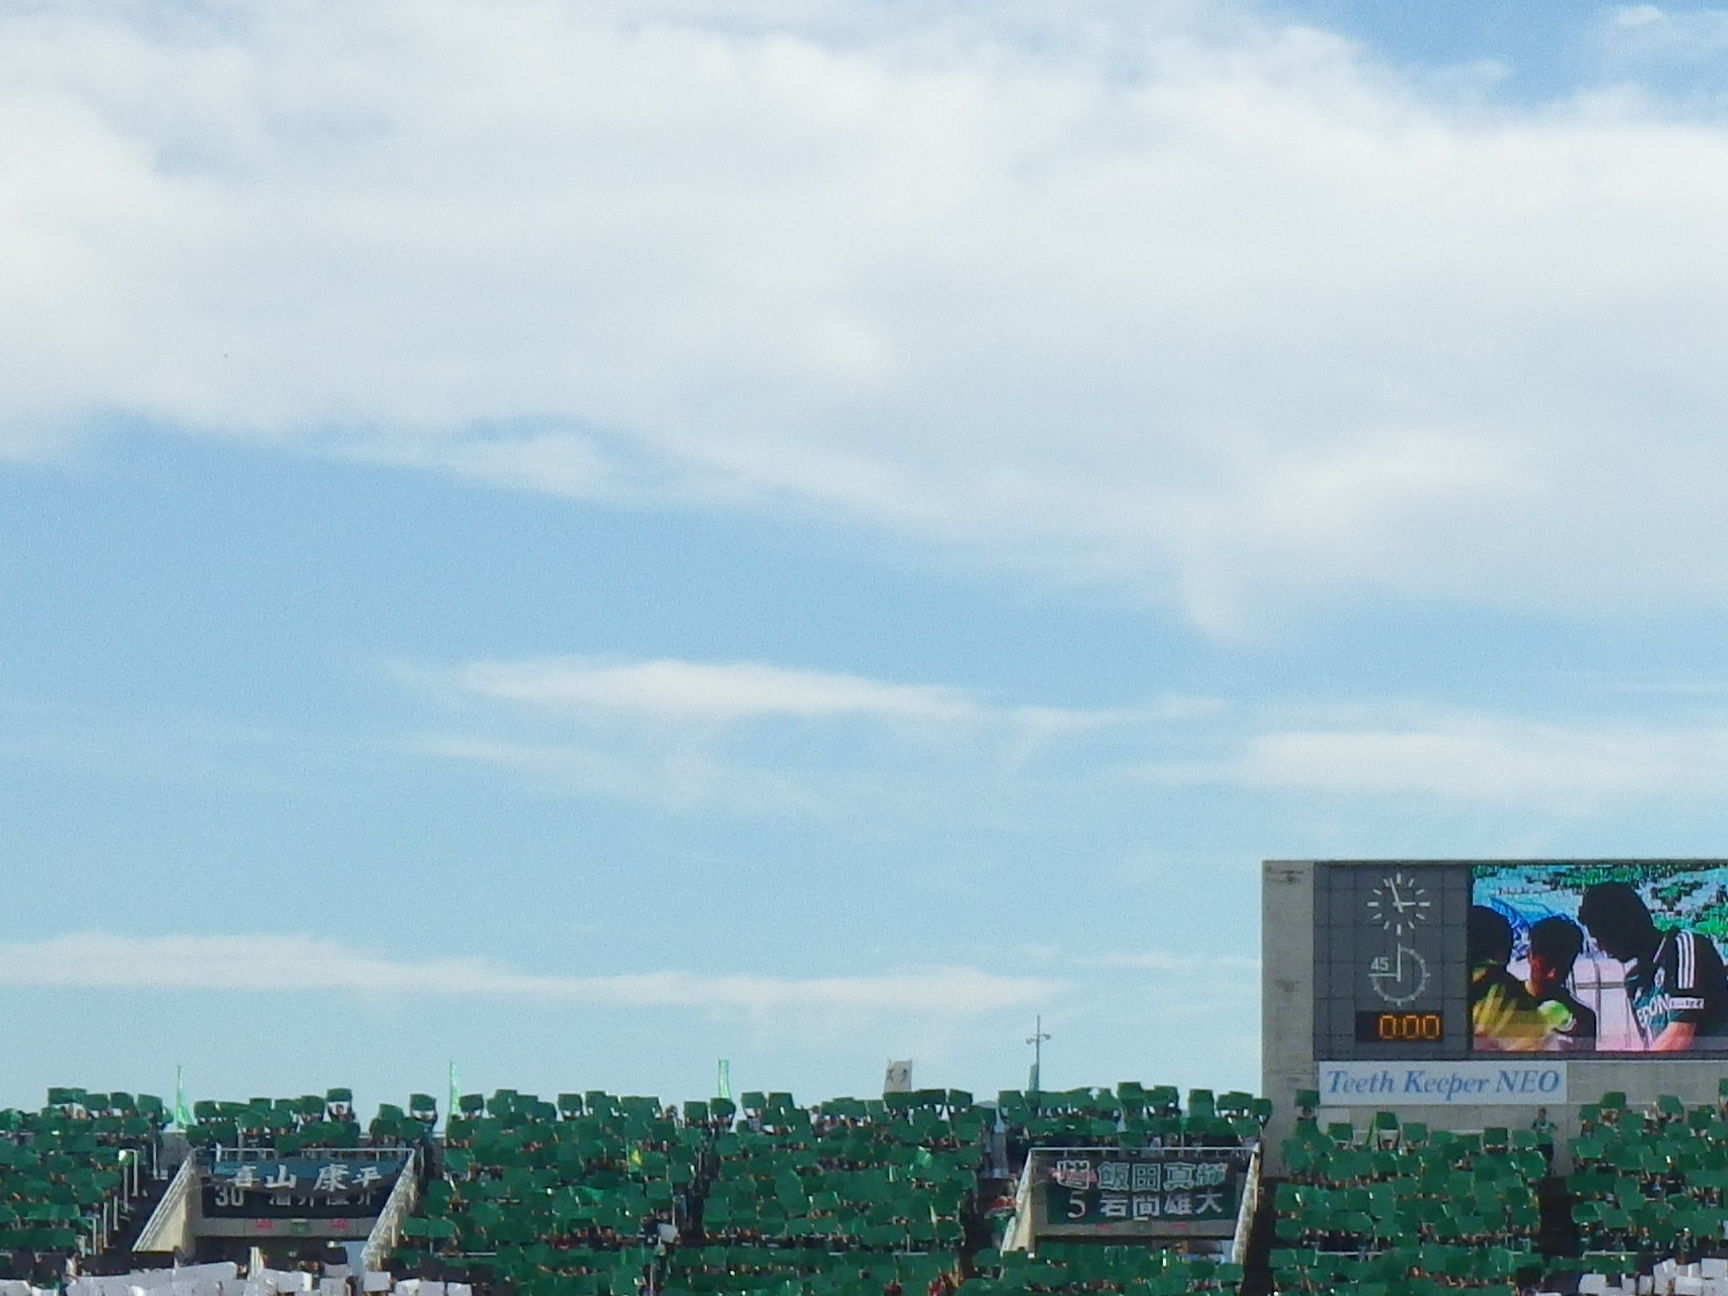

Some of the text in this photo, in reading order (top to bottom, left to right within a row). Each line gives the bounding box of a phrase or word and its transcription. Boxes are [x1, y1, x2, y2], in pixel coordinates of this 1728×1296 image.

[1371, 957, 1389, 971] 45
[1328, 1069, 1560, 1100] Teeth Keeper NEO
[1067, 1190, 1086, 1219] 5
